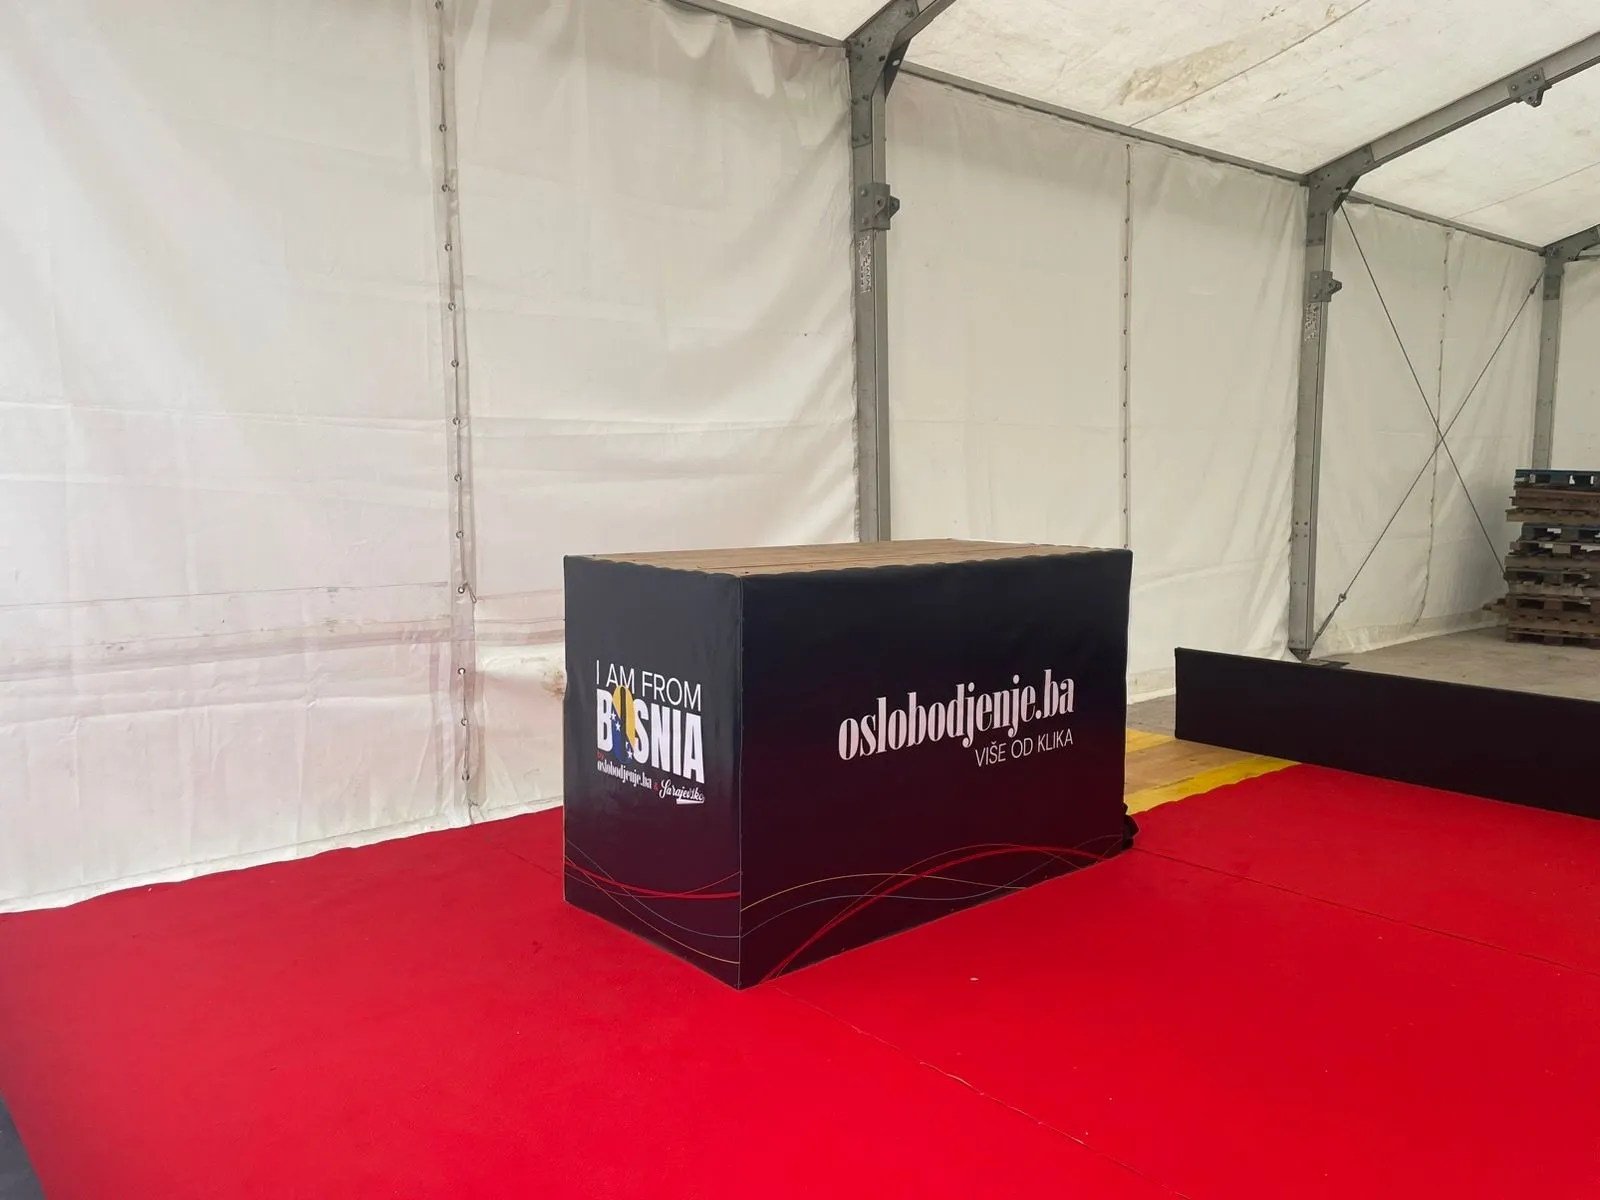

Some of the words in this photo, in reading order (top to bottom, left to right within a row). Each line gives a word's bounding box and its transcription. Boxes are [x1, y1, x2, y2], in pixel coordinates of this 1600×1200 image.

[596, 659, 600, 685] I
[605, 663, 635, 694] AM
[641, 670, 702, 712] FROM
[596, 685, 705, 784] BOSNIA
[838, 669, 1075, 761] oslobodjenje.ba
[597, 759, 652, 789] oslobodjenje.ba
[975, 740, 1007, 767] VIŠE
[1010, 737, 1034, 759] OD
[1037, 728, 1074, 753] KLIKA
